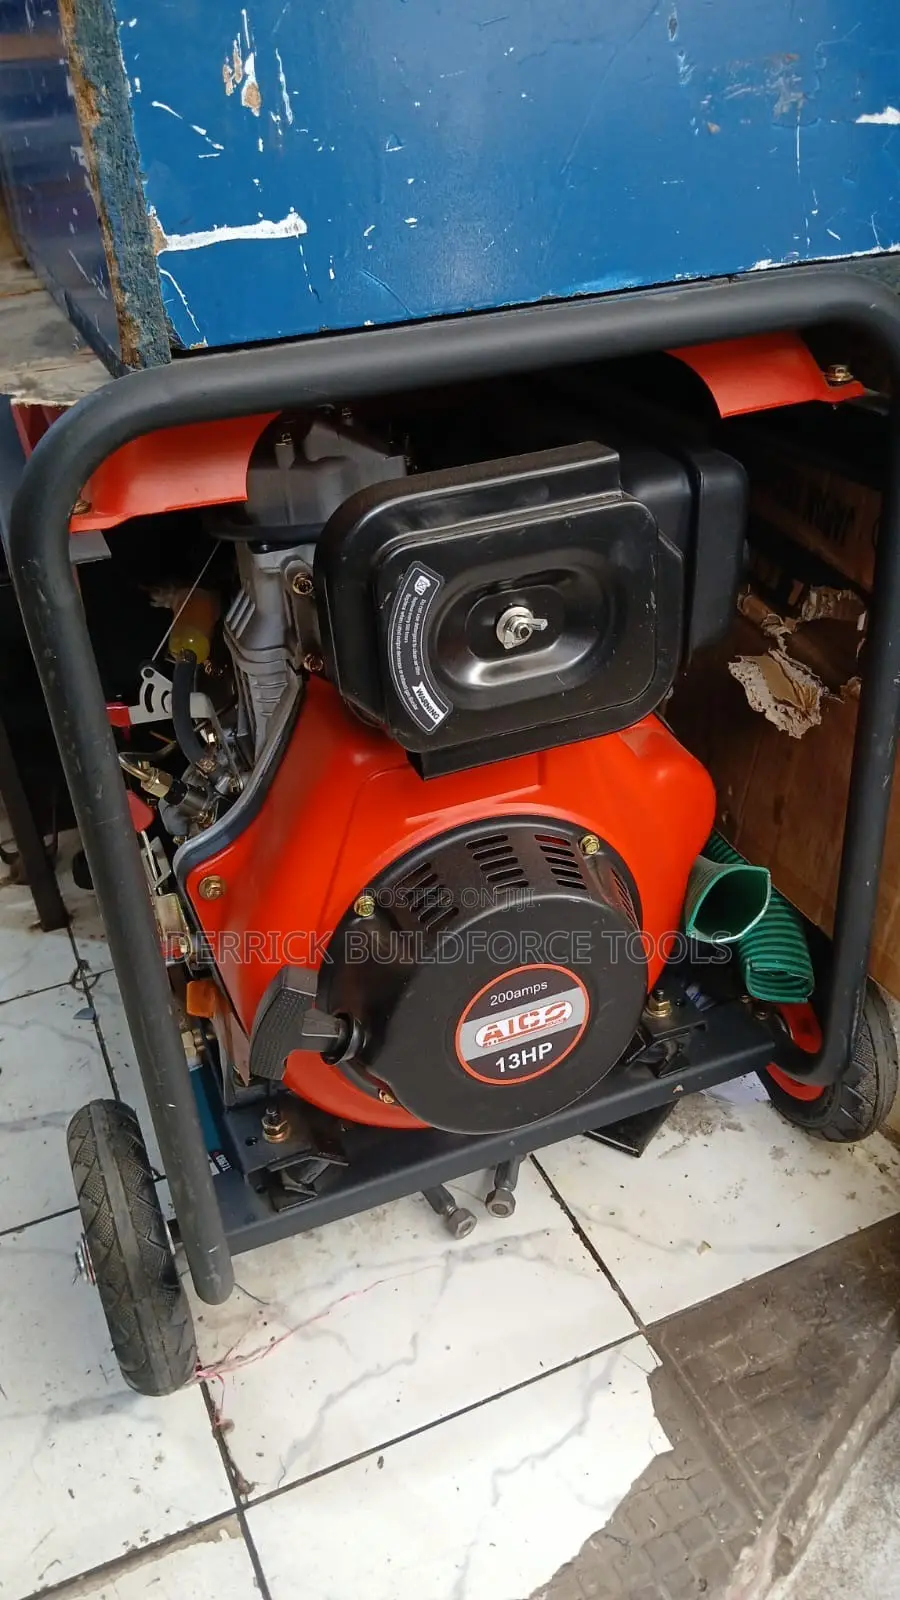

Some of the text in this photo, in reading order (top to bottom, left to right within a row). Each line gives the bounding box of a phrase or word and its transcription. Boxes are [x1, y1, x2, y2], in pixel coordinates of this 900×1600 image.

[415, 688, 440, 720] WARNING
[490, 981, 548, 1006] 200amps
[495, 1042, 553, 1073] 13HP
